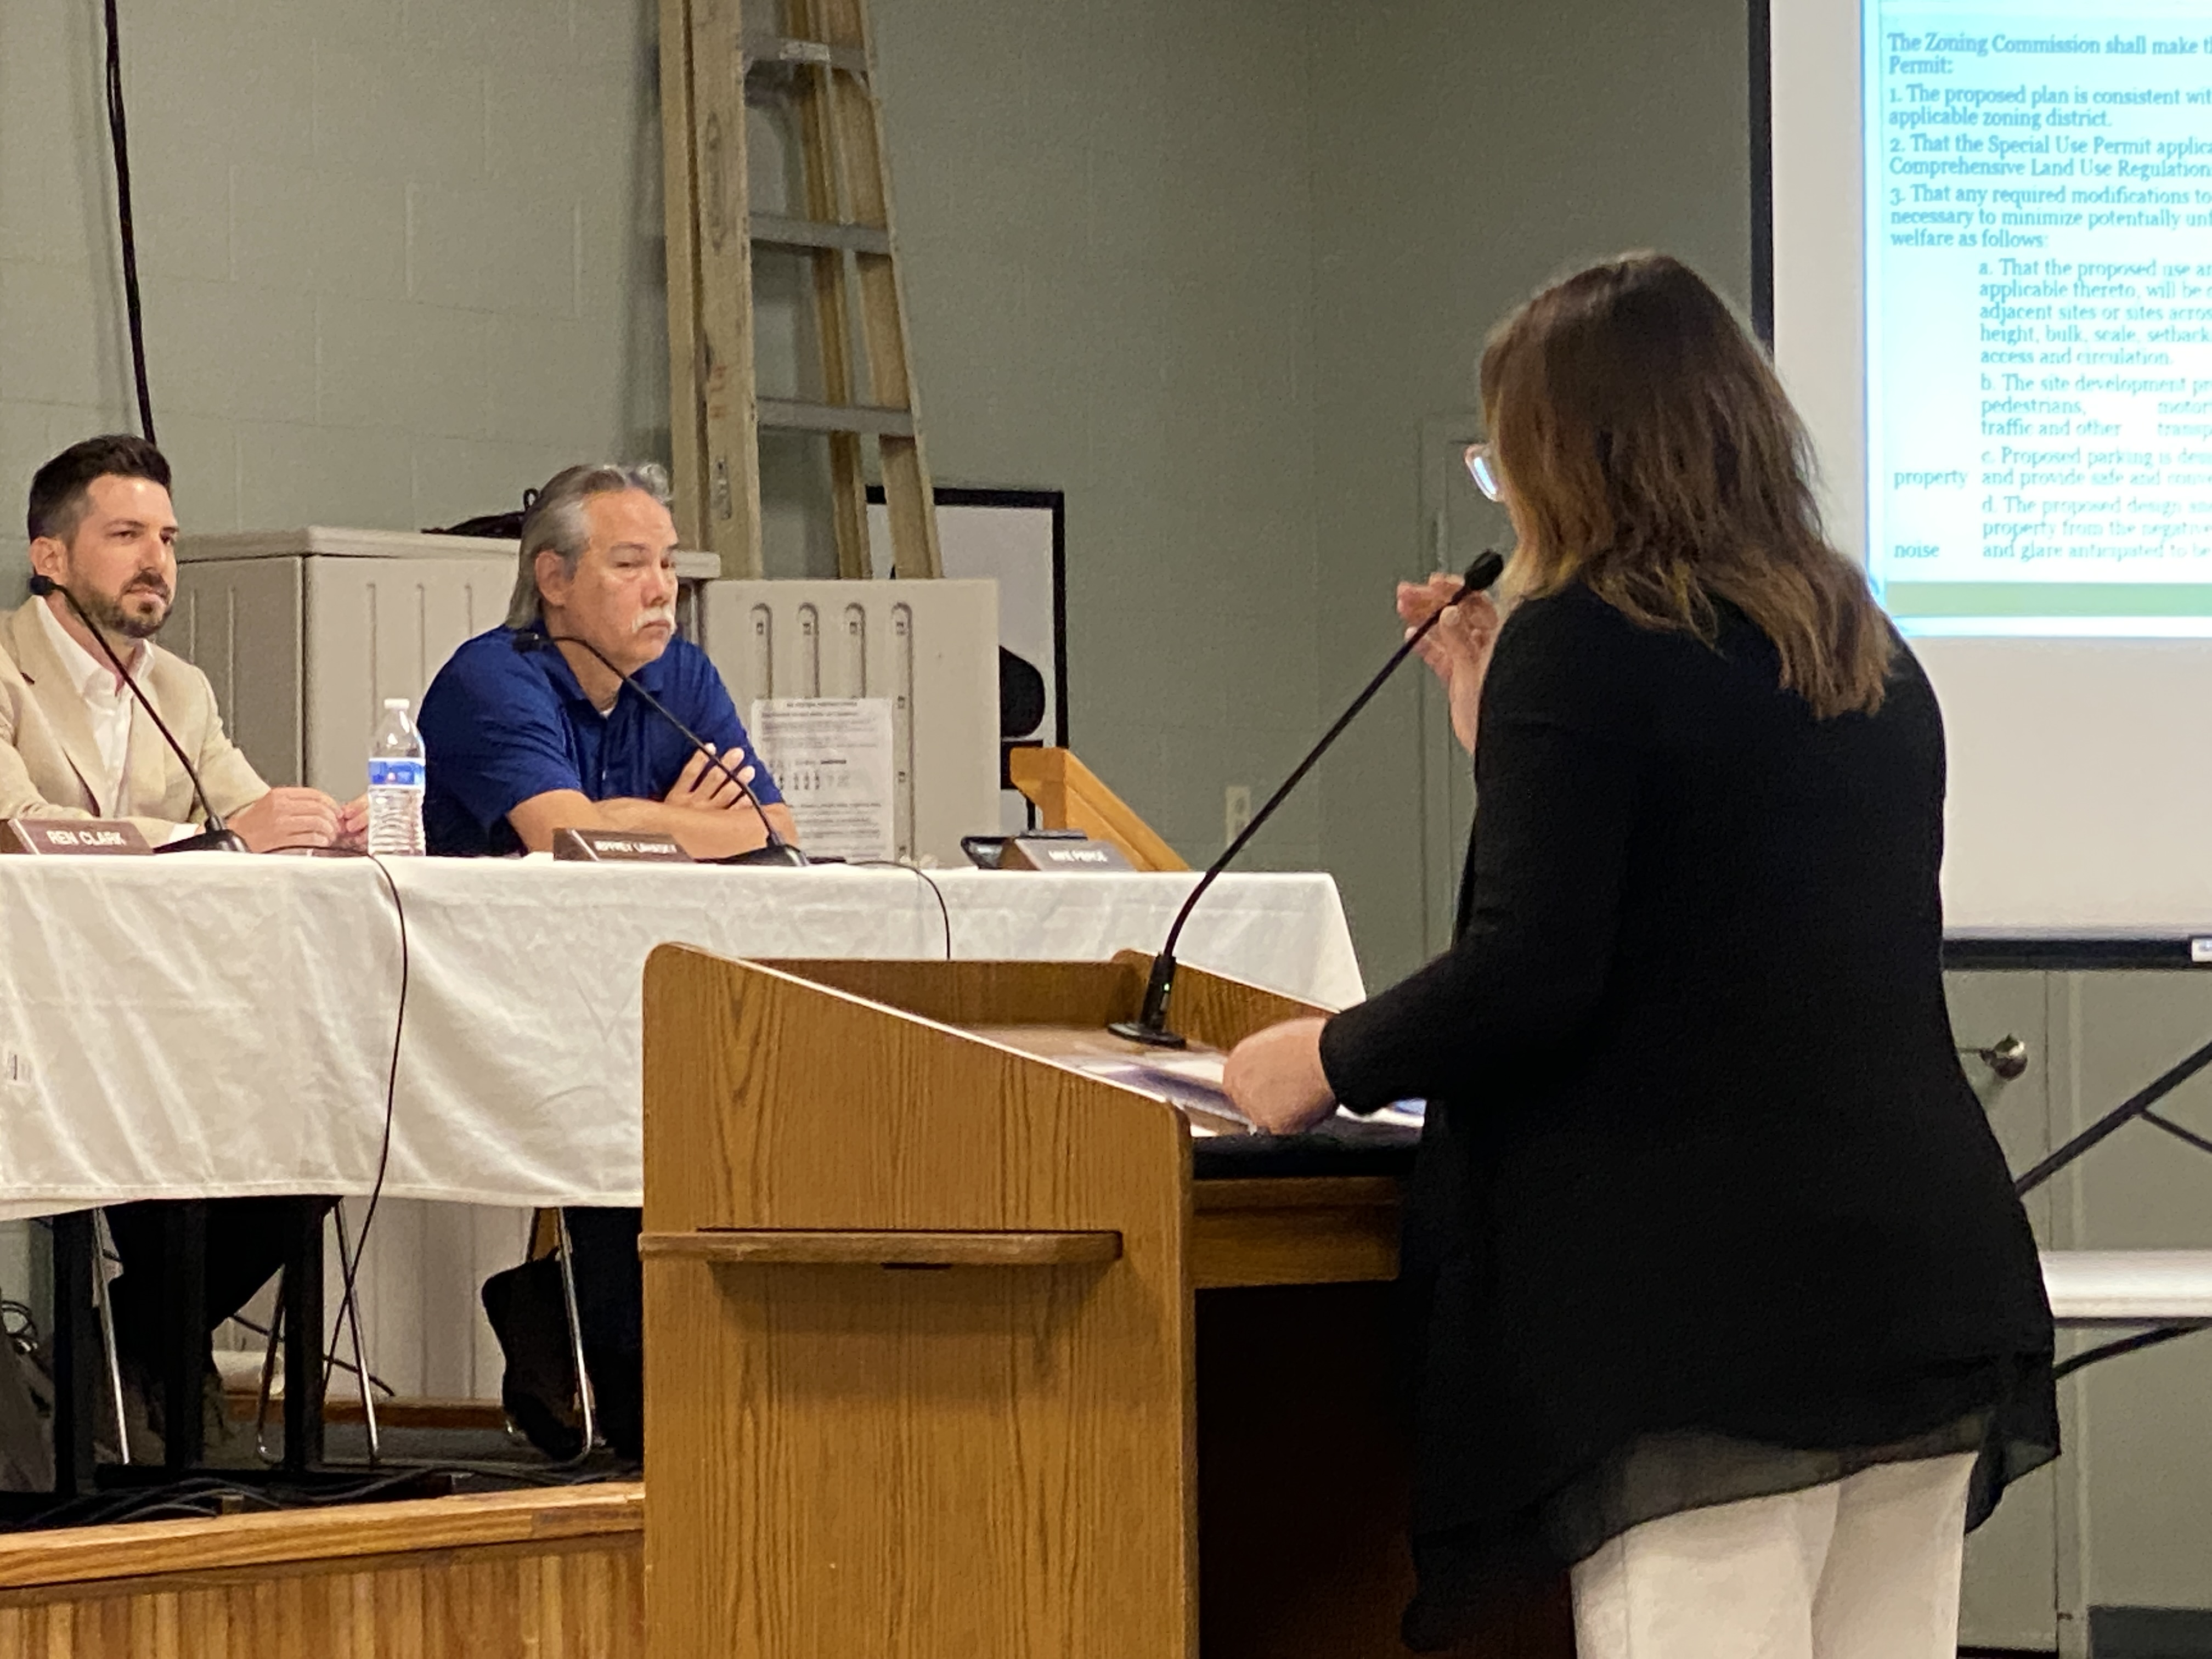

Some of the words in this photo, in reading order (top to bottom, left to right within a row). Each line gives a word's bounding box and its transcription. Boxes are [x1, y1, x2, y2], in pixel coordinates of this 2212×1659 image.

[1887, 32, 1922, 52] The
[1925, 31, 1988, 57] Zoning
[1991, 33, 2100, 53] Commission
[2105, 33, 2146, 54] shall
[2152, 36, 2198, 54] make
[1889, 55, 1954, 75] Permit:
[1889, 88, 1903, 103] 1.
[1906, 83, 1940, 103] The
[1945, 84, 2025, 108] proposed
[2032, 84, 2069, 109] plan
[2074, 85, 2087, 104] is
[2093, 87, 2180, 104] consistent
[1888, 105, 1978, 129] applicable
[1983, 108, 2041, 131] zoning
[2045, 108, 2112, 127] district.
[1890, 138, 1905, 153] 2.
[1910, 132, 1949, 152] That
[1955, 133, 1983, 152] the
[1988, 135, 2049, 160] Special
[2056, 135, 2087, 154] Use
[2094, 136, 2151, 155] Permit
[1889, 155, 2025, 179] Comprehensive
[2031, 158, 2074, 176] Land
[2081, 158, 2112, 177] Use
[1890, 188, 1905, 206] 3.
[1910, 183, 1950, 202] That
[1955, 189, 1987, 207] any
[1992, 185, 2066, 210] required
[2072, 185, 2190, 204] modifications
[2196, 189, 2212, 205] to
[1891, 211, 1974, 229] necessary
[1979, 208, 1996, 224] to
[2002, 208, 2083, 226] minimize
[2088, 208, 2182, 232] potentially
[1891, 228, 1954, 246] welfare
[1959, 234, 1977, 246] as
[1999, 258, 2039, 275] That
[2045, 258, 2072, 275] the
[2078, 259, 2156, 282] proposed
[2163, 265, 2190, 276] use
[1979, 279, 2068, 304] applicable
[2146, 281, 2175, 299] will
[2182, 281, 2202, 299] be
[1979, 302, 2052, 326] adjacent
[2059, 304, 2096, 320] sites
[2102, 307, 2120, 320] or
[2126, 306, 2164, 321] sites
[1980, 351, 2034, 364] access
[2039, 347, 2072, 364] and
[2001, 373, 2034, 392] The
[2041, 376, 2069, 392] site
[2075, 374, 2186, 397] development
[1981, 418, 2032, 436] traffic
[2039, 419, 2070, 436] and
[2076, 420, 2121, 436] other
